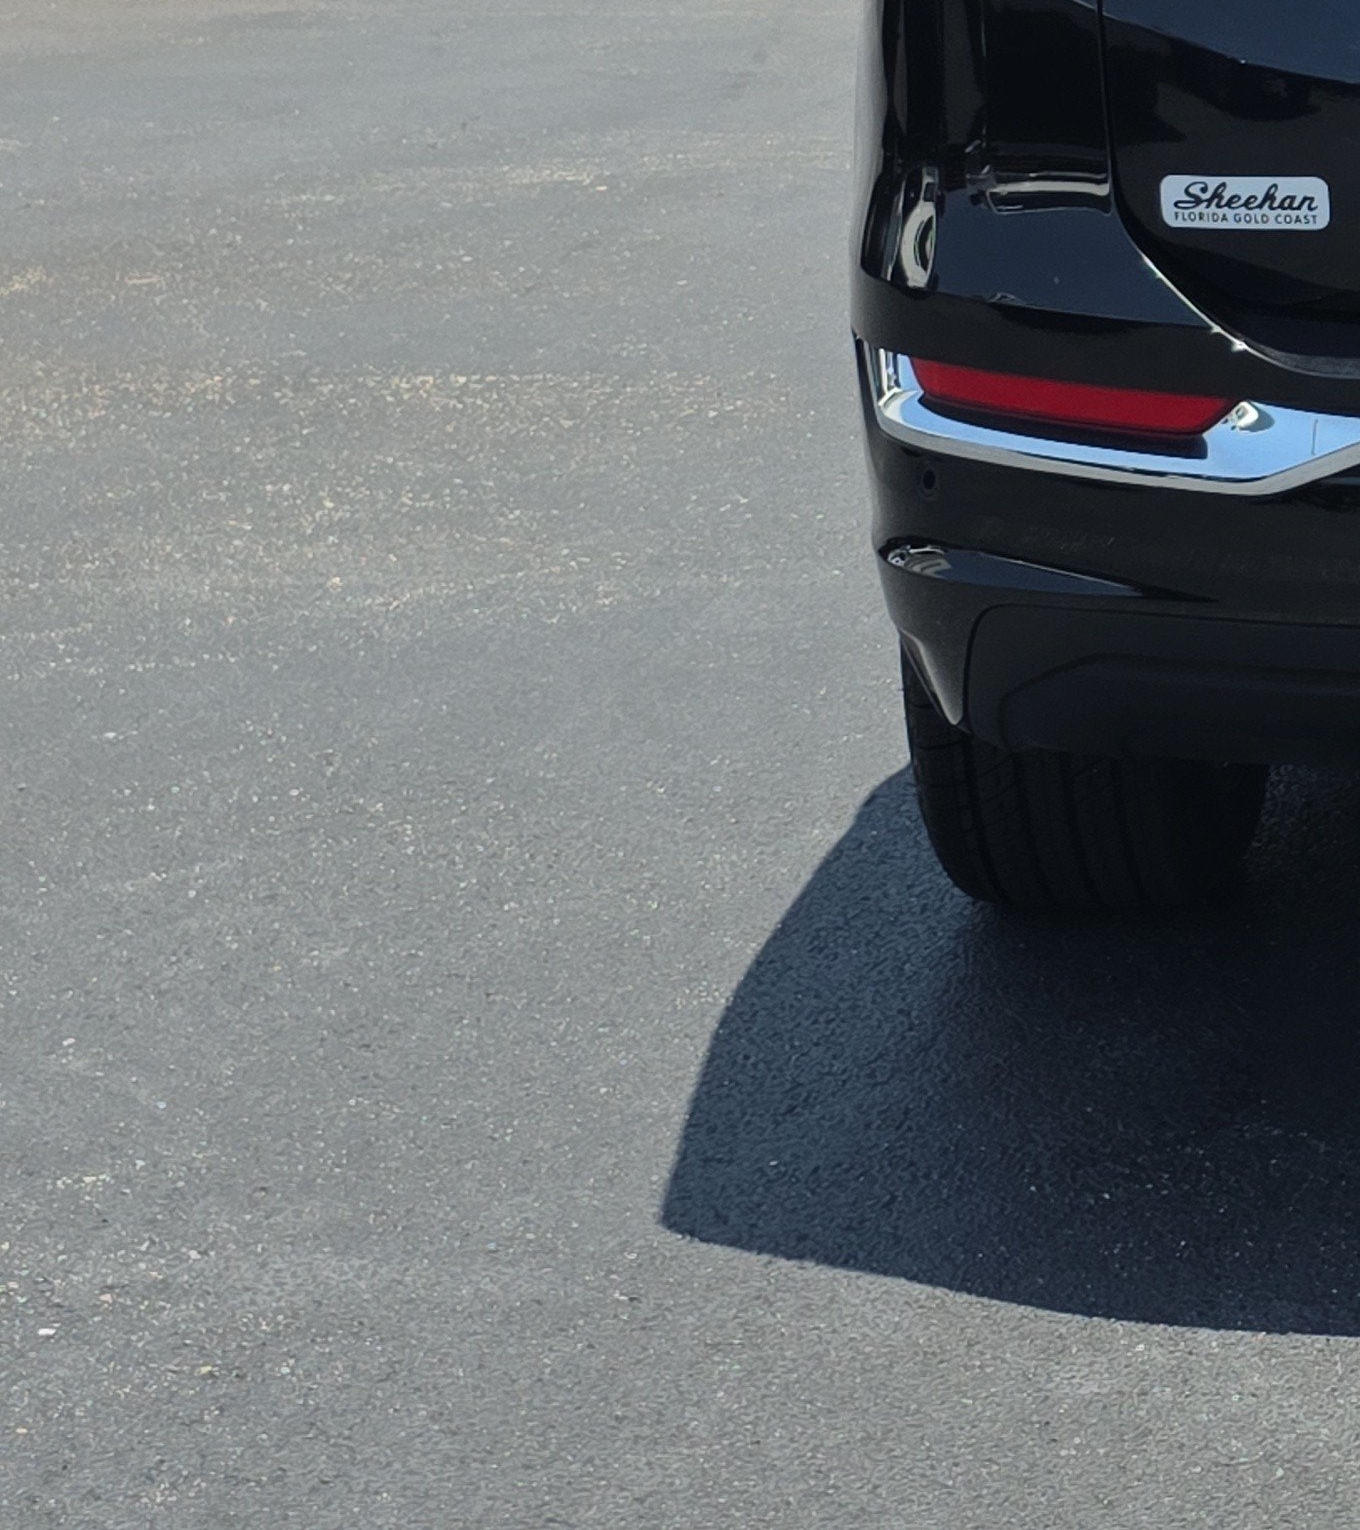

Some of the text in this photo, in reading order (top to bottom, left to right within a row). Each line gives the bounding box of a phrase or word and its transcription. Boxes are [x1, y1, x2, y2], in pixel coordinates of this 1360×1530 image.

[1174, 181, 1318, 211] Sheehan
[1174, 212, 1317, 224] FLORIDA GOLD COAST
